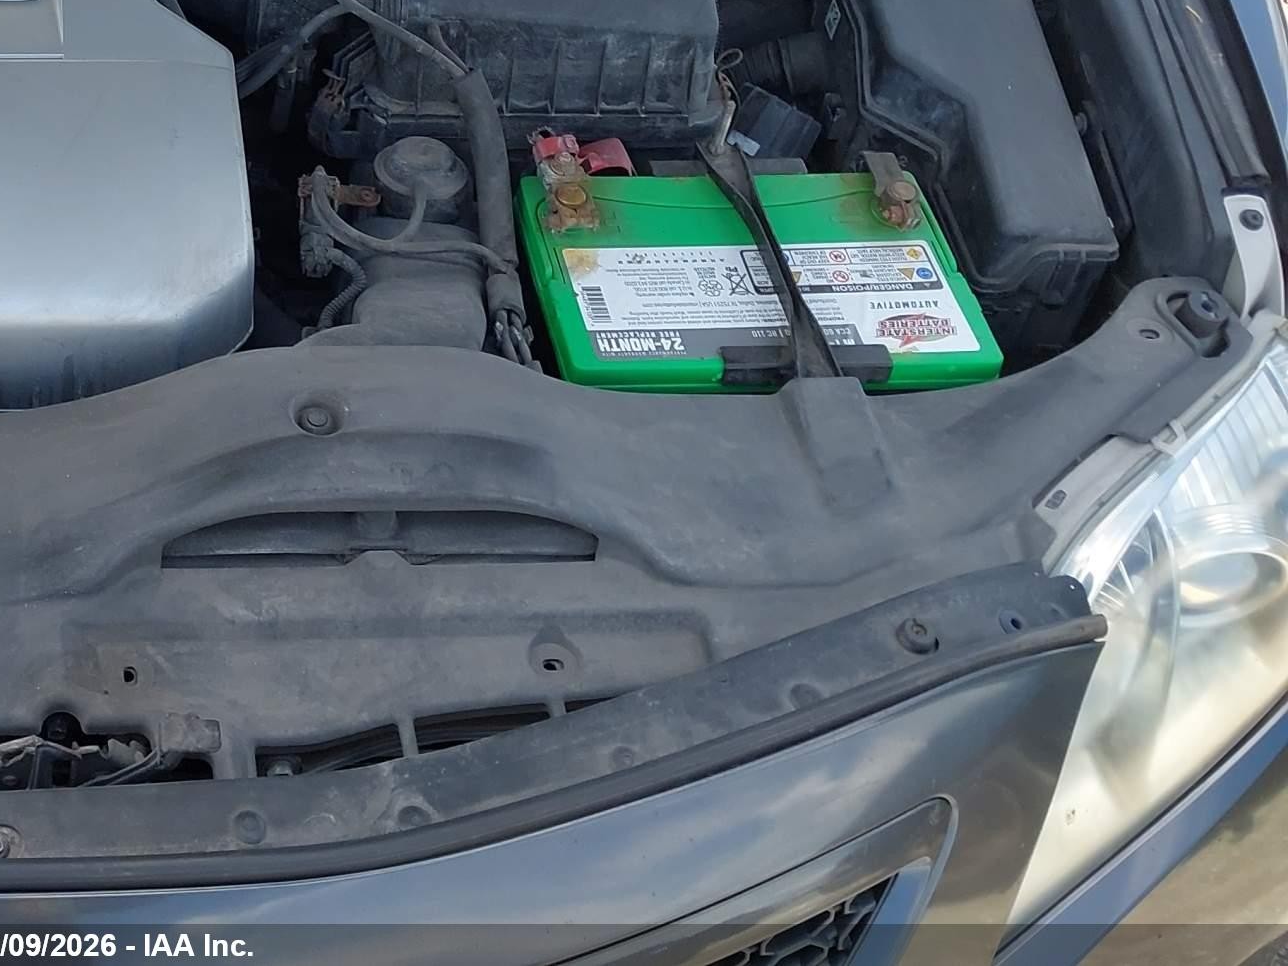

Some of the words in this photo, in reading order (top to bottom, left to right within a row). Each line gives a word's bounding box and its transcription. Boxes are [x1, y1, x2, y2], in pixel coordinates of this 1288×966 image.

[832, 282, 914, 292] DANGER/POISON
[869, 300, 939, 310] AUTOMOTIVE
[880, 319, 949, 329] BATTERIES
[878, 327, 955, 337] INTERSTATE
[597, 337, 684, 352] 24-MONTH
